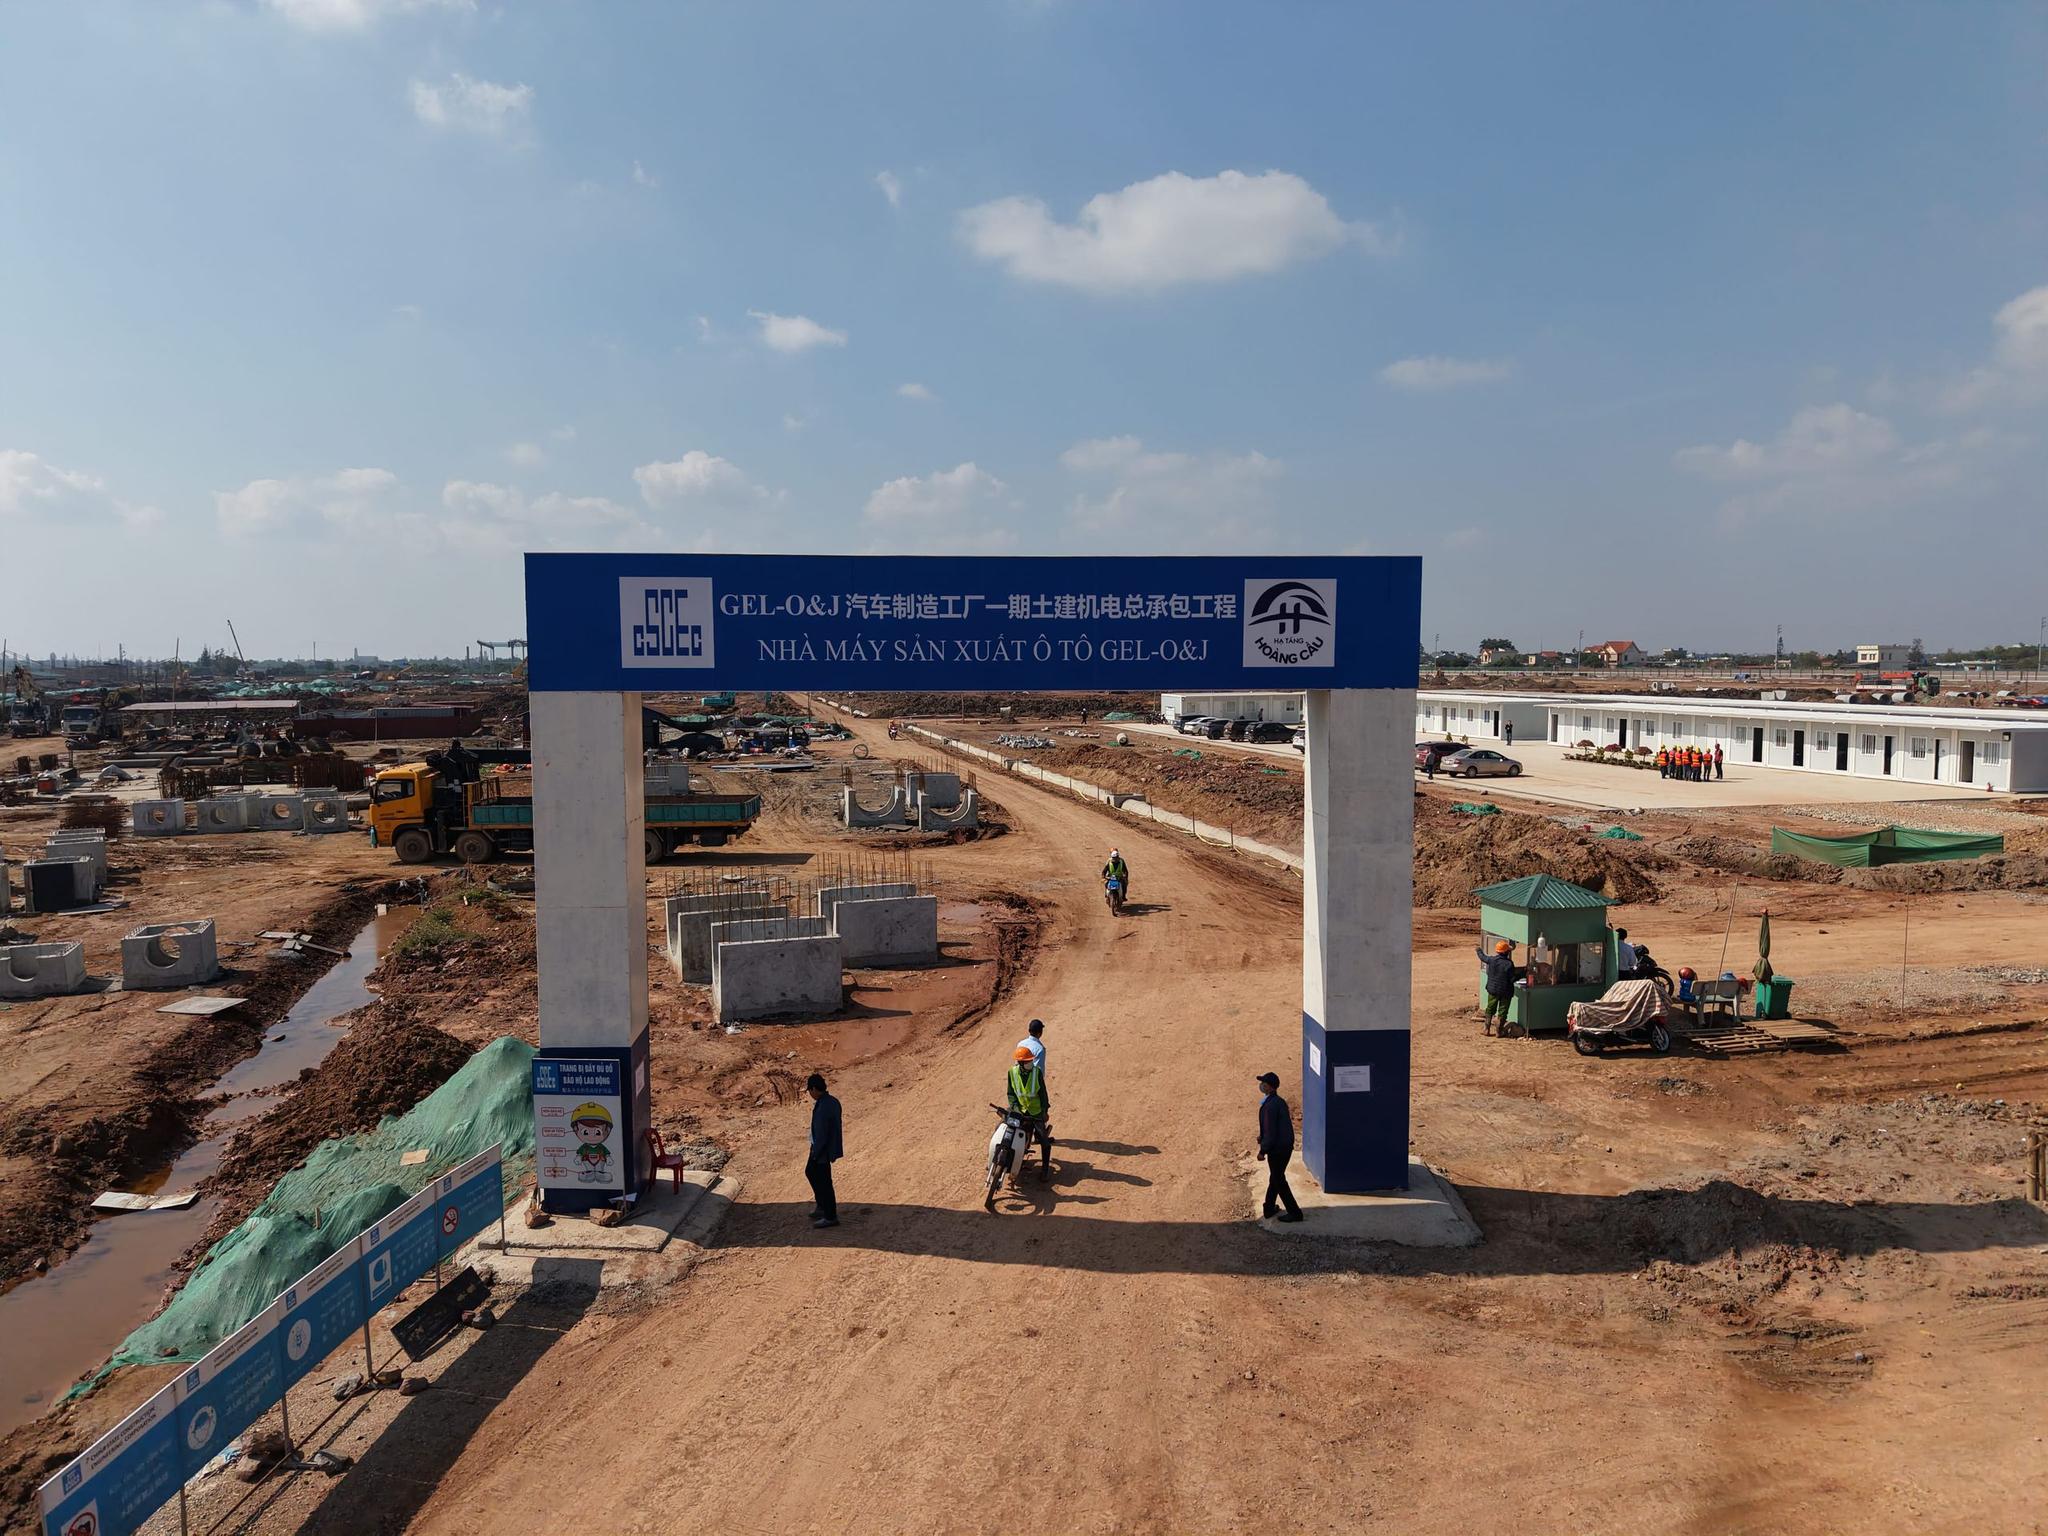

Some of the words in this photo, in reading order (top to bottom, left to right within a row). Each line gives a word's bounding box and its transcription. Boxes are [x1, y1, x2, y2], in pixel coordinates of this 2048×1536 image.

[720, 593, 840, 616] GEL-O&J
[846, 593, 1237, 619] 汽车制造工厂一期土建机电总承包工程
[758, 633, 817, 661] NHÀ
[825, 633, 888, 661] MÁY
[894, 633, 946, 662] SẢN
[954, 633, 1027, 661] XUẤT
[1033, 634, 1051, 661] Ô
[1058, 634, 1092, 661] TÔ
[1100, 639, 1209, 661] GEL-O&J
[1254, 637, 1298, 664] HOÀNG
